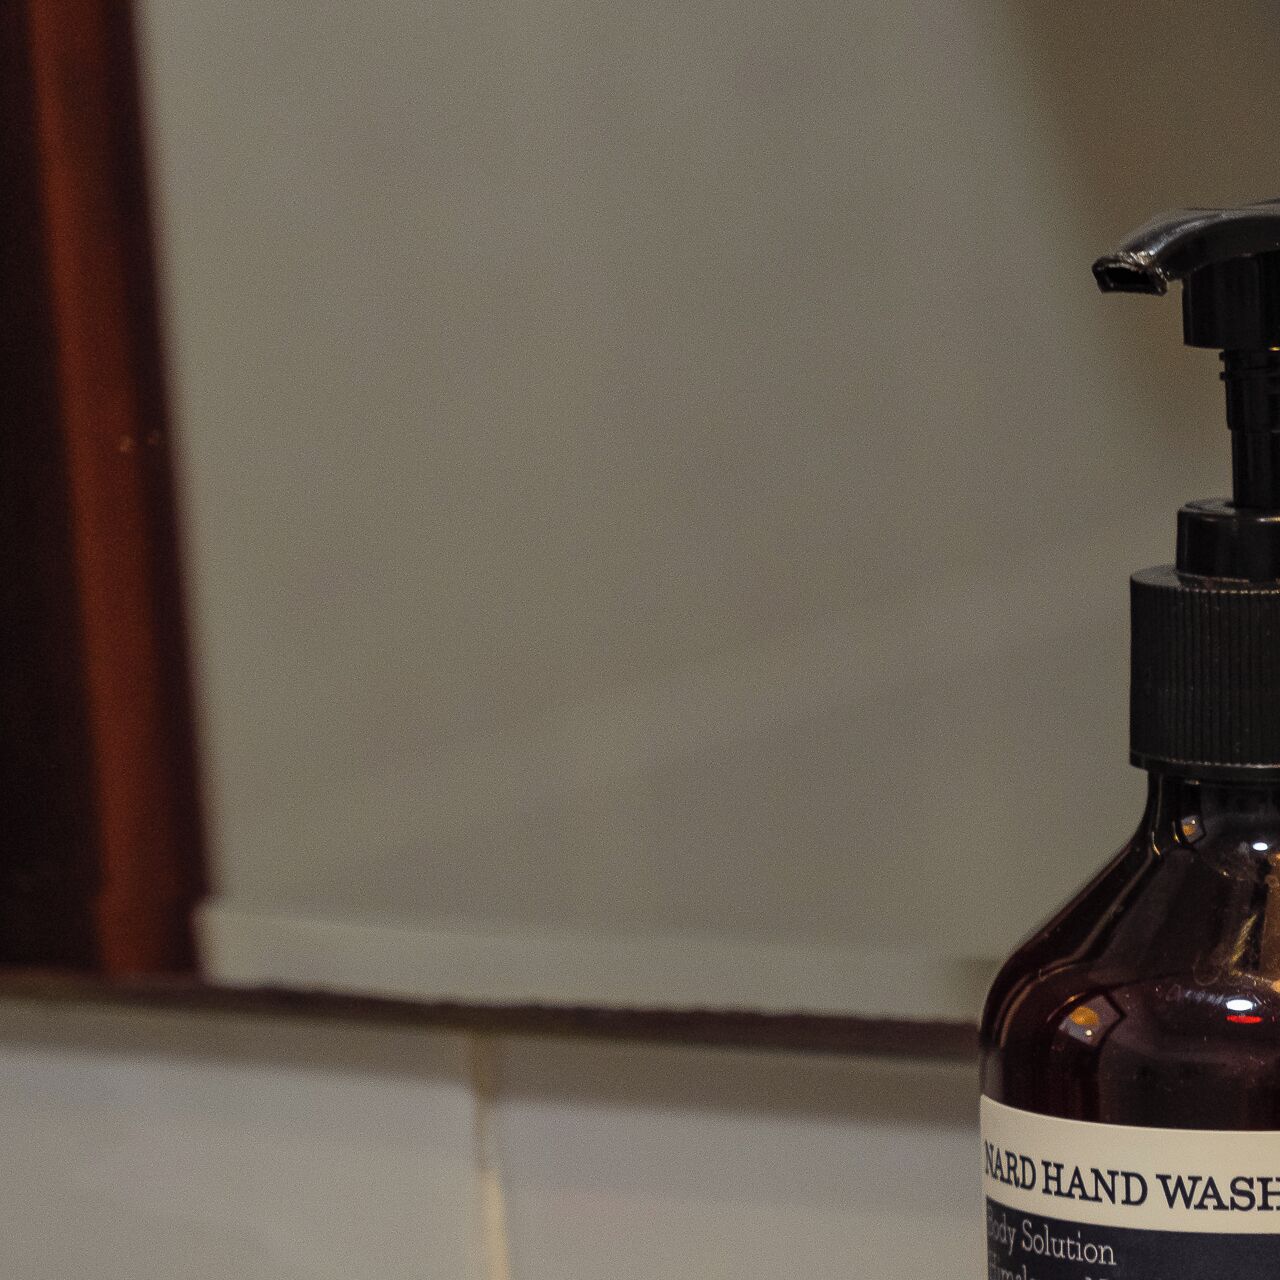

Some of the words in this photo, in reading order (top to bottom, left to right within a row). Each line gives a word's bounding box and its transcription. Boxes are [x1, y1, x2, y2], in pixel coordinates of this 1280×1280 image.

[985, 1139, 1037, 1191] NARD
[1041, 1160, 1148, 1206] HAND
[1022, 1219, 1117, 1266] Solution
